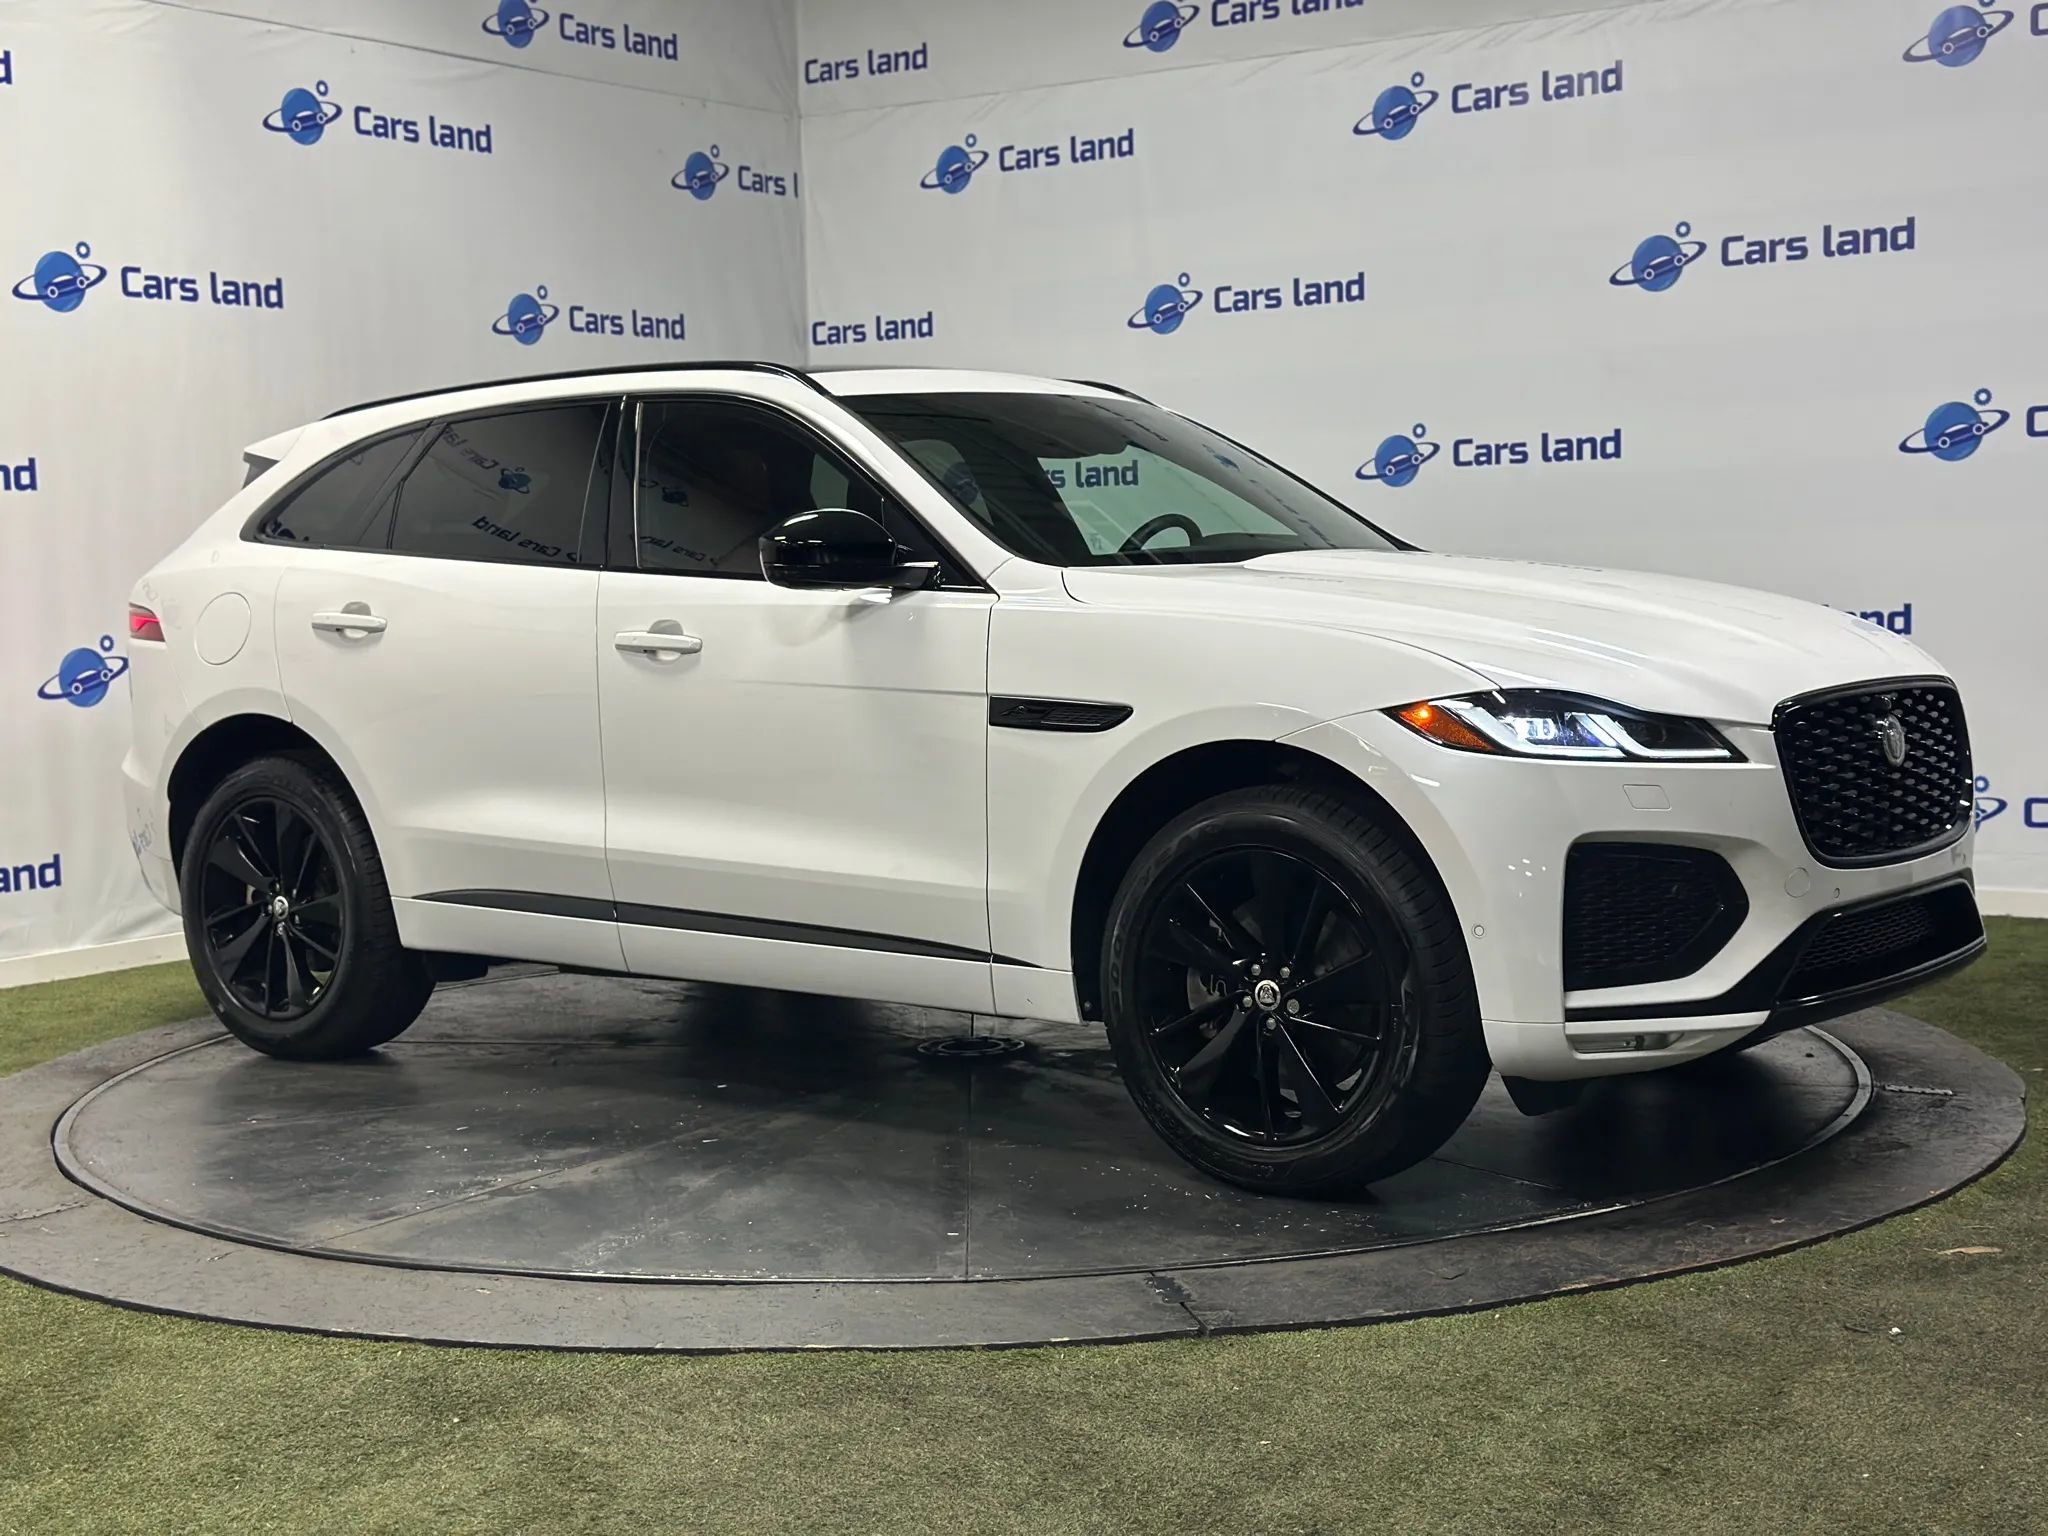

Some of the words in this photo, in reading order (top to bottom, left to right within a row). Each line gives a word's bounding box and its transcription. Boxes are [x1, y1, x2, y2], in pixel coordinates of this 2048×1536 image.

[1211, 0, 1281, 27] Cars
[559, 12, 616, 50] Cars
[623, 23, 679, 61] land
[804, 58, 860, 85] Cars
[867, 41, 928, 76] land
[1451, 81, 1530, 114] Cars
[1541, 59, 1623, 102] land
[353, 105, 420, 144] Cars
[428, 114, 493, 155] land
[998, 144, 1061, 173] Cars
[1069, 127, 1135, 164] land
[737, 165, 787, 197] Cars
[1720, 235, 1809, 267] Cars
[1822, 215, 1916, 258] land
[120, 265, 200, 303] Cars
[209, 271, 285, 310] land
[1213, 285, 1283, 314] Cars
[1292, 271, 1365, 307] land
[568, 305, 625, 336] Cars
[631, 308, 686, 341] land
[811, 320, 867, 347] Cars
[875, 310, 934, 342] land
[1452, 438, 1529, 468] Cars
[1540, 427, 1622, 463] land
[1075, 460, 1139, 489] land
